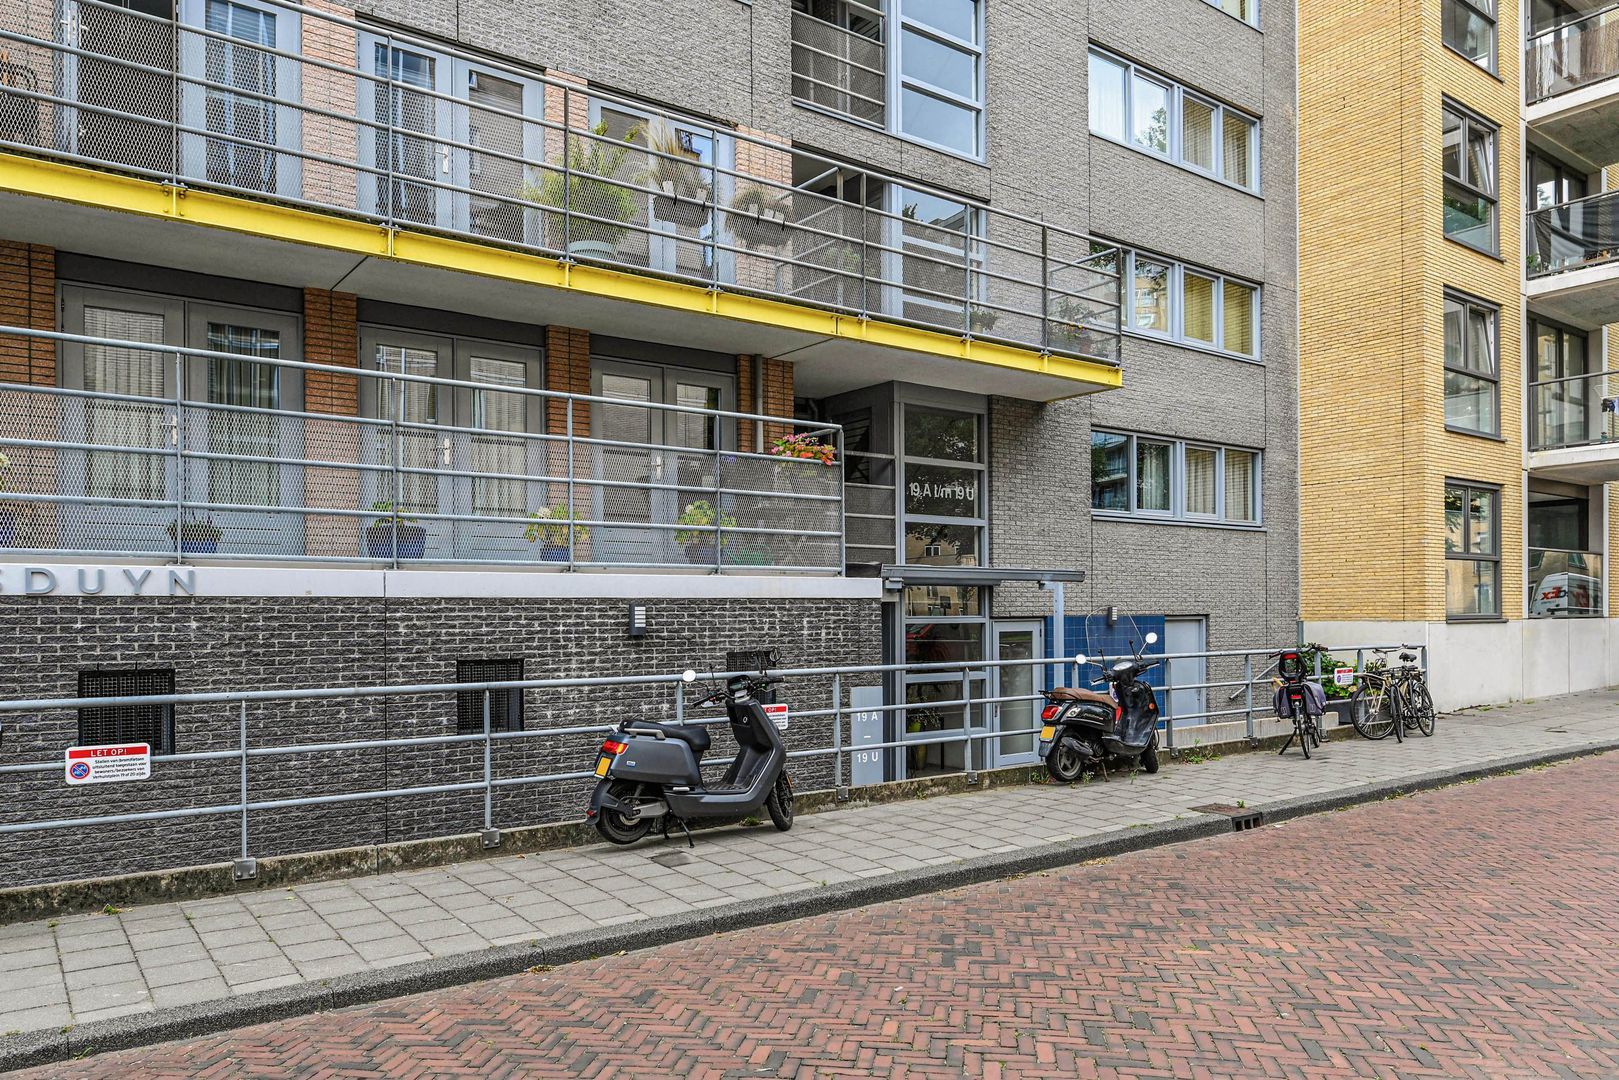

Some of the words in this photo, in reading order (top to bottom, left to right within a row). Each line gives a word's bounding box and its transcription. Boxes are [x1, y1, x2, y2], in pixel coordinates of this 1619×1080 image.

[909, 482, 920, 496] 19
[923, 483, 932, 497] A
[0, 567, 196, 595] DUYN
[857, 712, 868, 722] 19
[871, 712, 878, 721] A
[90, 749, 108, 757] LET
[110, 748, 127, 756] OP!
[857, 752, 868, 763] 19
[872, 752, 878, 762] U
